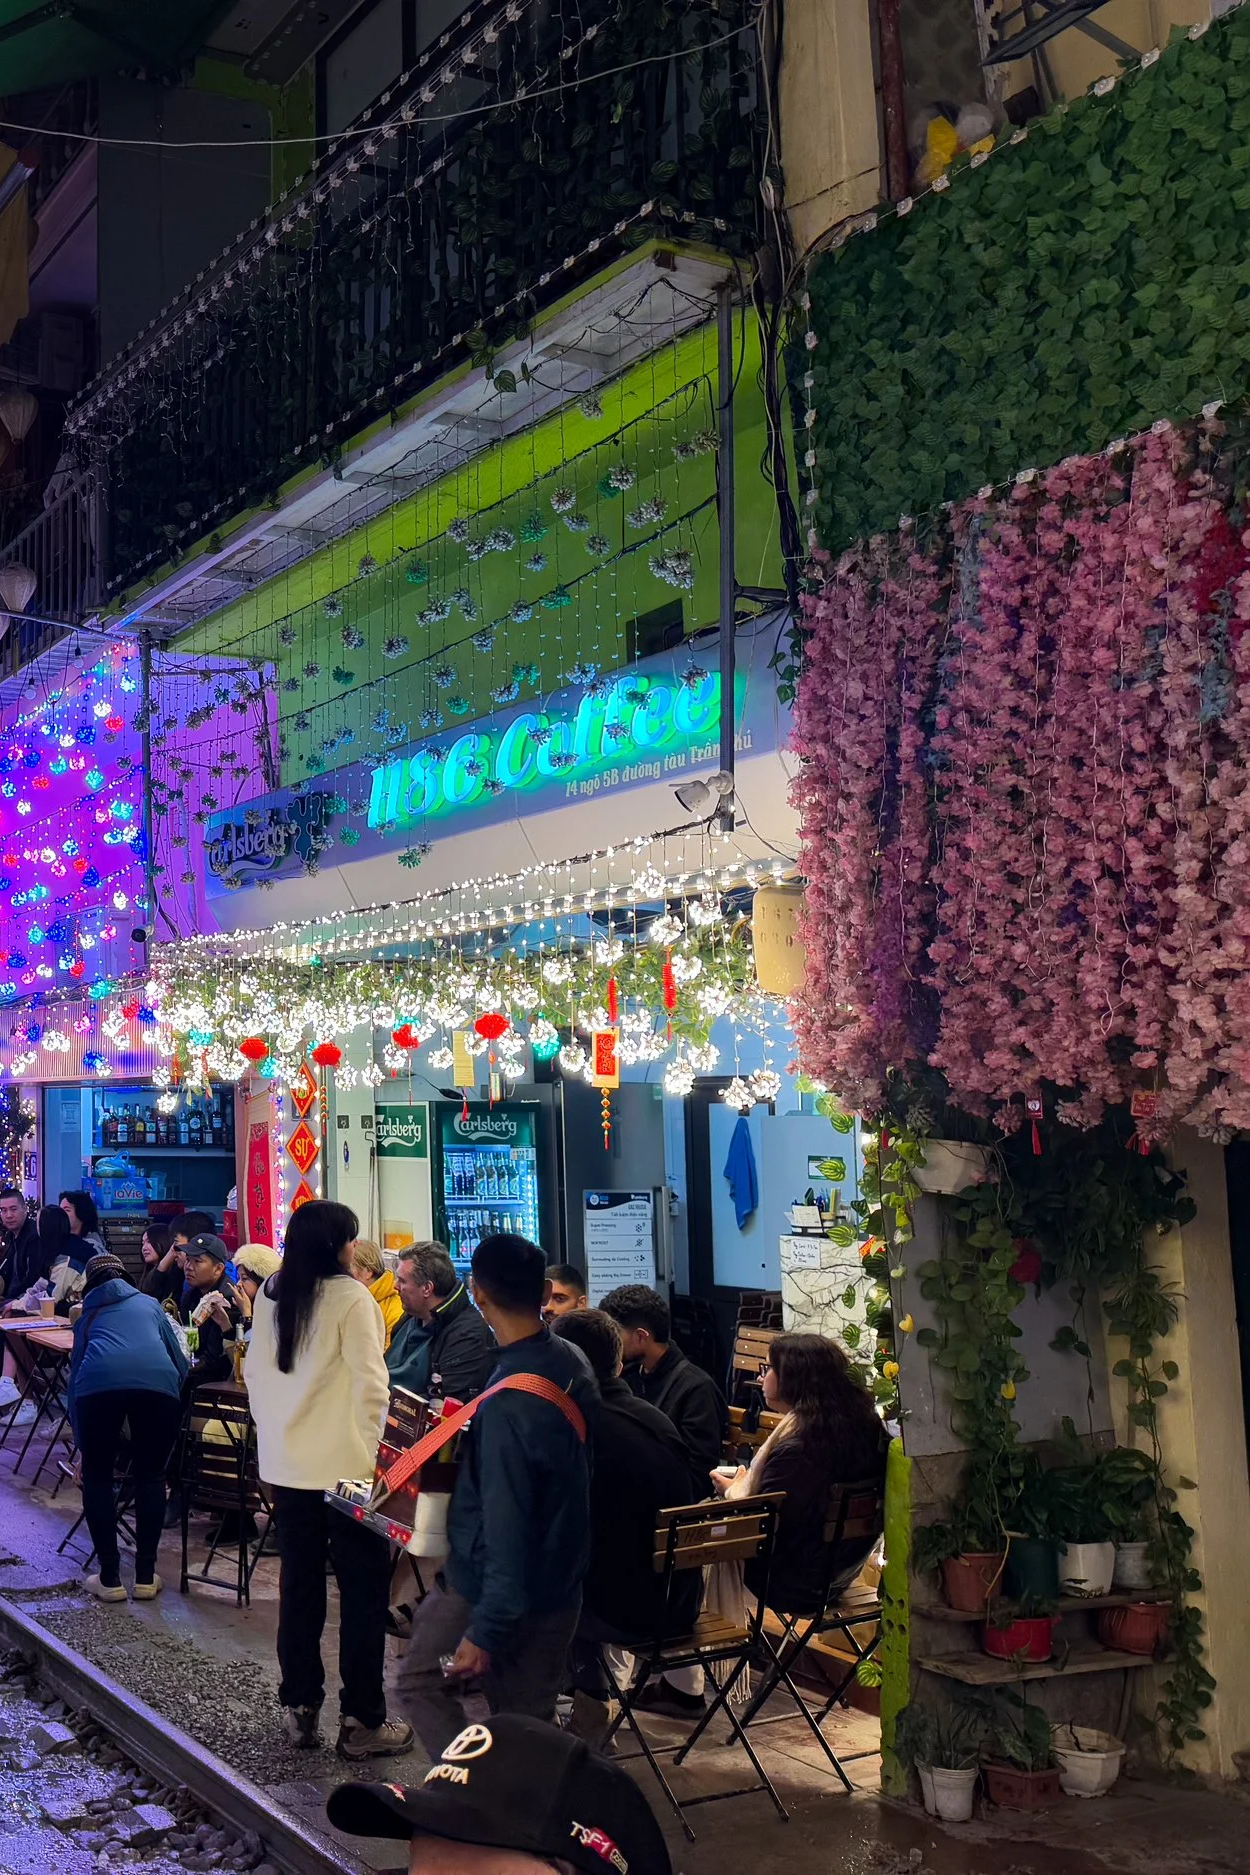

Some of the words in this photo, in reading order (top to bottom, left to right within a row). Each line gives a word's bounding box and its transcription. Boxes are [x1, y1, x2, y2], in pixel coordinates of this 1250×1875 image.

[496, 671, 721, 790] Coffee
[565, 779, 578, 797] 14
[664, 752, 688, 773] tàu
[453, 1111, 517, 1141] Carlsberg
